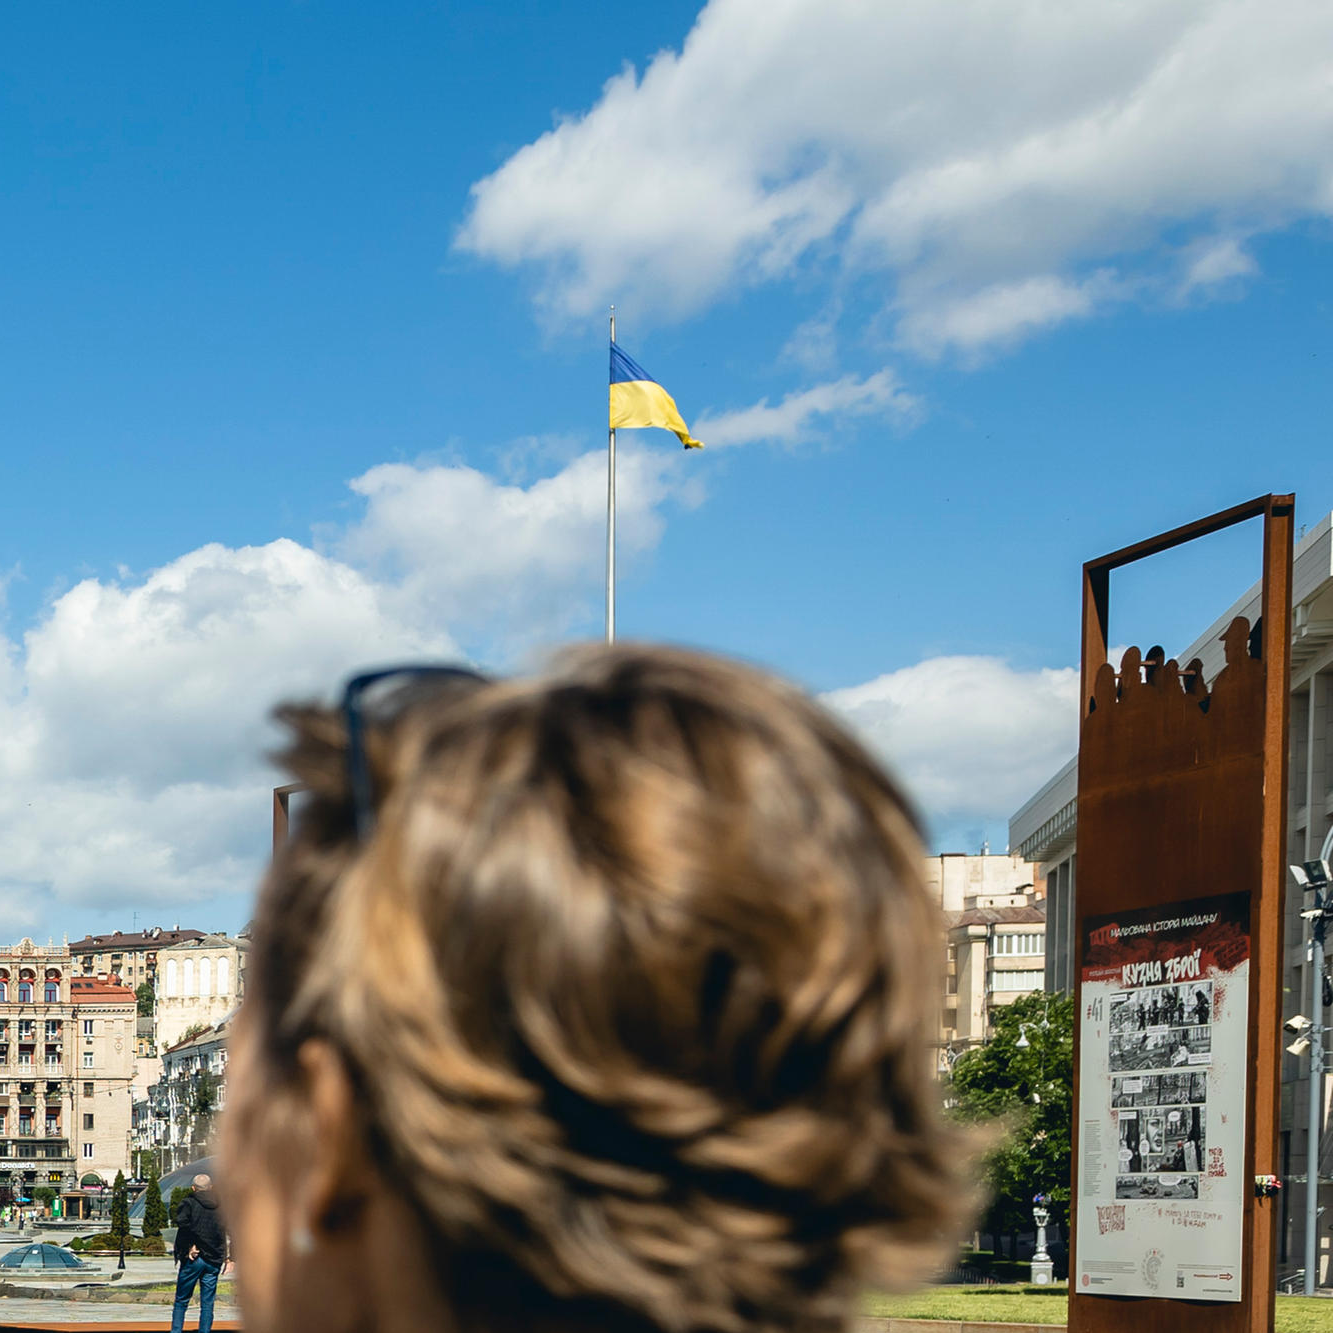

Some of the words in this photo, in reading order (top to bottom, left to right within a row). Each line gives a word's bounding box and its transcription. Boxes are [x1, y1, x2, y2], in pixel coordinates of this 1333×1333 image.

[1110, 924, 1152, 938] МАЛЬОВАНА
[1153, 917, 1180, 932] ІСТОРІЯ
[1181, 912, 1218, 928] МАЙДАНУ
